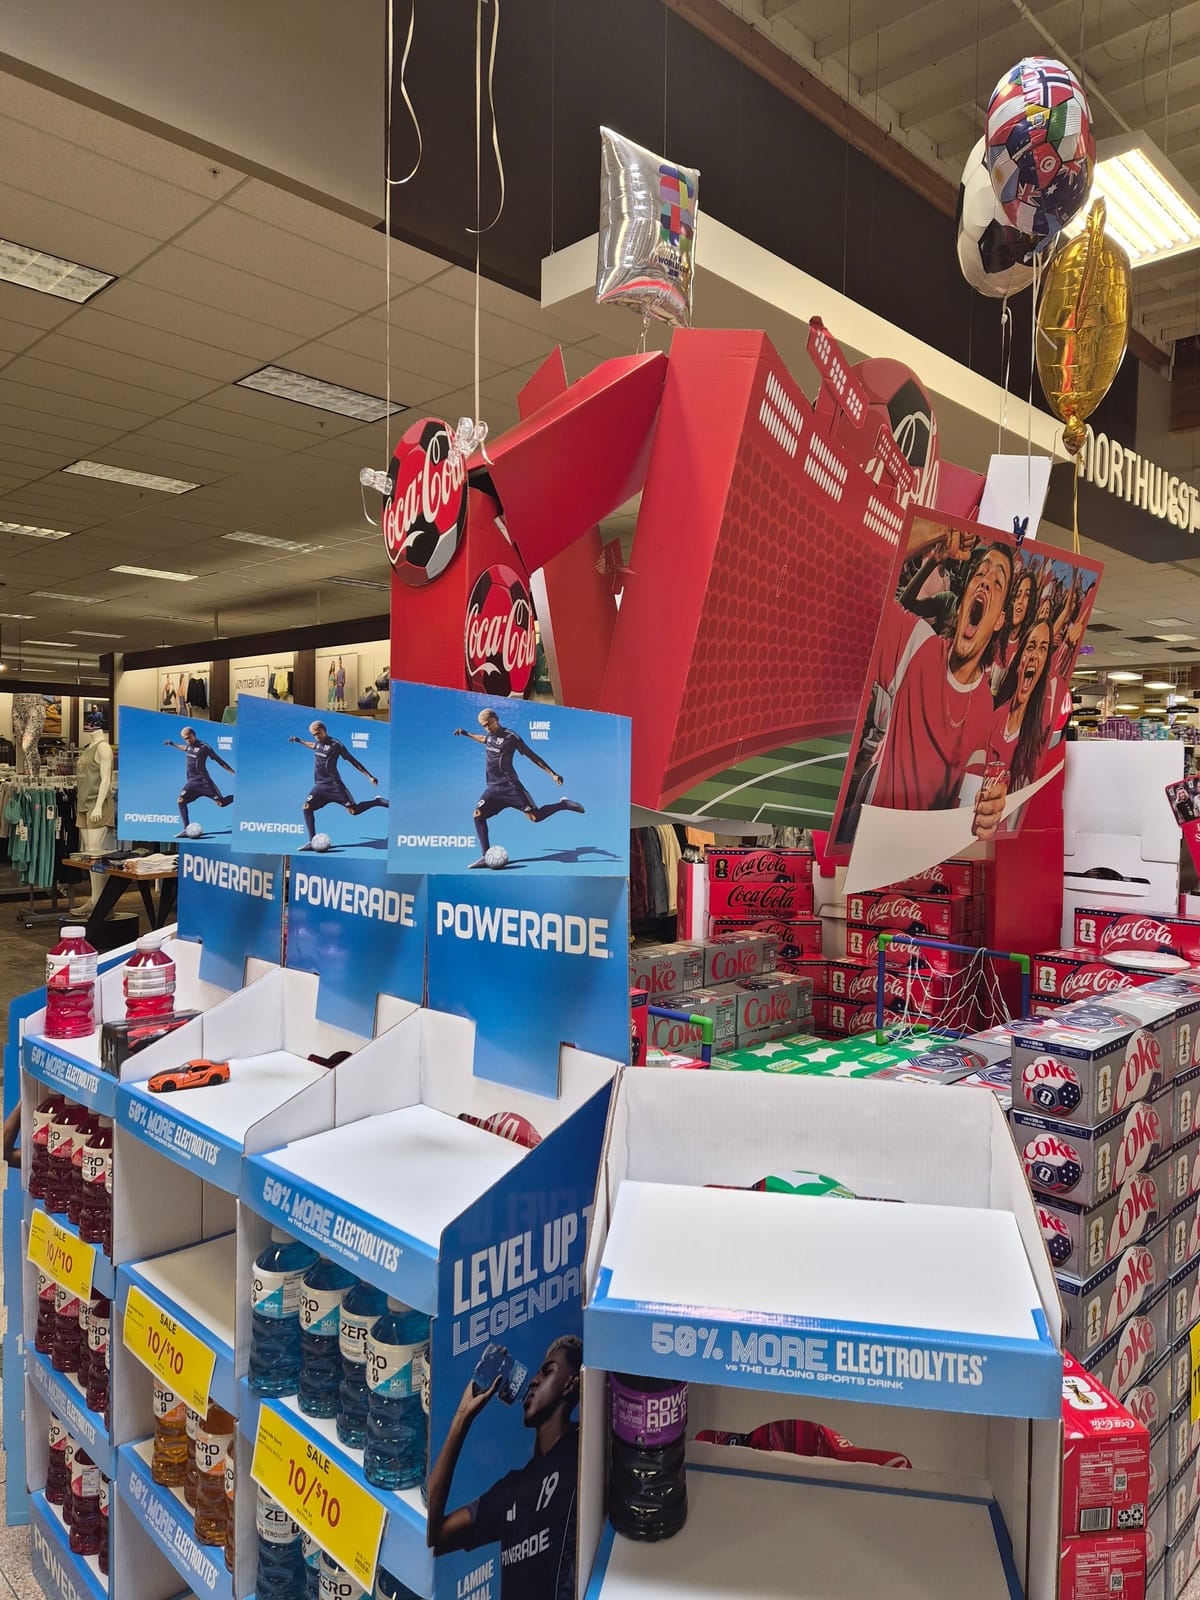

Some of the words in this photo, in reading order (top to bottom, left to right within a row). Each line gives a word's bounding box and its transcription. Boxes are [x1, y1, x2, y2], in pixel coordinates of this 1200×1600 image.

[466, 598, 536, 676] Coca-Cola
[124, 813, 180, 825] POWERADE
[239, 821, 305, 835] POWERADE
[397, 834, 476, 848] POWERADE
[182, 854, 275, 901] POWERADE
[731, 854, 788, 882] Coca-Cola
[294, 872, 416, 928] POWERADE
[727, 885, 798, 908] Coca-Cola
[867, 897, 923, 925] Coca-Cola
[436, 901, 610, 959] POWERADE
[1101, 918, 1173, 950] Coca-Cola
[711, 951, 758, 981] Coke
[743, 995, 792, 1028] Coke
[1022, 1057, 1078, 1082] Coke
[1112, 1037, 1162, 1113] Coke
[128, 1099, 148, 1127] 50%
[147, 1110, 176, 1142] MORE
[1023, 1136, 1078, 1161] Coke
[1112, 1111, 1161, 1188] Coke
[263, 1176, 292, 1213] 50%
[291, 1192, 335, 1237] MORE
[1105, 1180, 1157, 1263] Coke
[453, 1230, 538, 1316] LEVEL
[543, 1212, 578, 1273] UP
[1103, 1252, 1154, 1338] Coke
[159, 1313, 178, 1336] SALE
[341, 1322, 369, 1341] ZER
[147, 1326, 185, 1375] 10/$10
[651, 1322, 724, 1361] 50%
[731, 1330, 829, 1374] MORE
[835, 1341, 984, 1387] ELECTROLYTES
[739, 1364, 764, 1375] THE
[763, 1367, 815, 1381] LEADING
[816, 1372, 865, 1387] SPORTS
[867, 1377, 904, 1390] DRINK
[304, 1444, 332, 1476] SALE
[129, 1471, 148, 1509] 50%
[147, 1494, 176, 1541] MORE
[288, 1459, 341, 1527] 10/$10
[536, 1471, 560, 1512] 19
[502, 1527, 550, 1567] POWERADE
[457, 1558, 494, 1599] LAMINE
